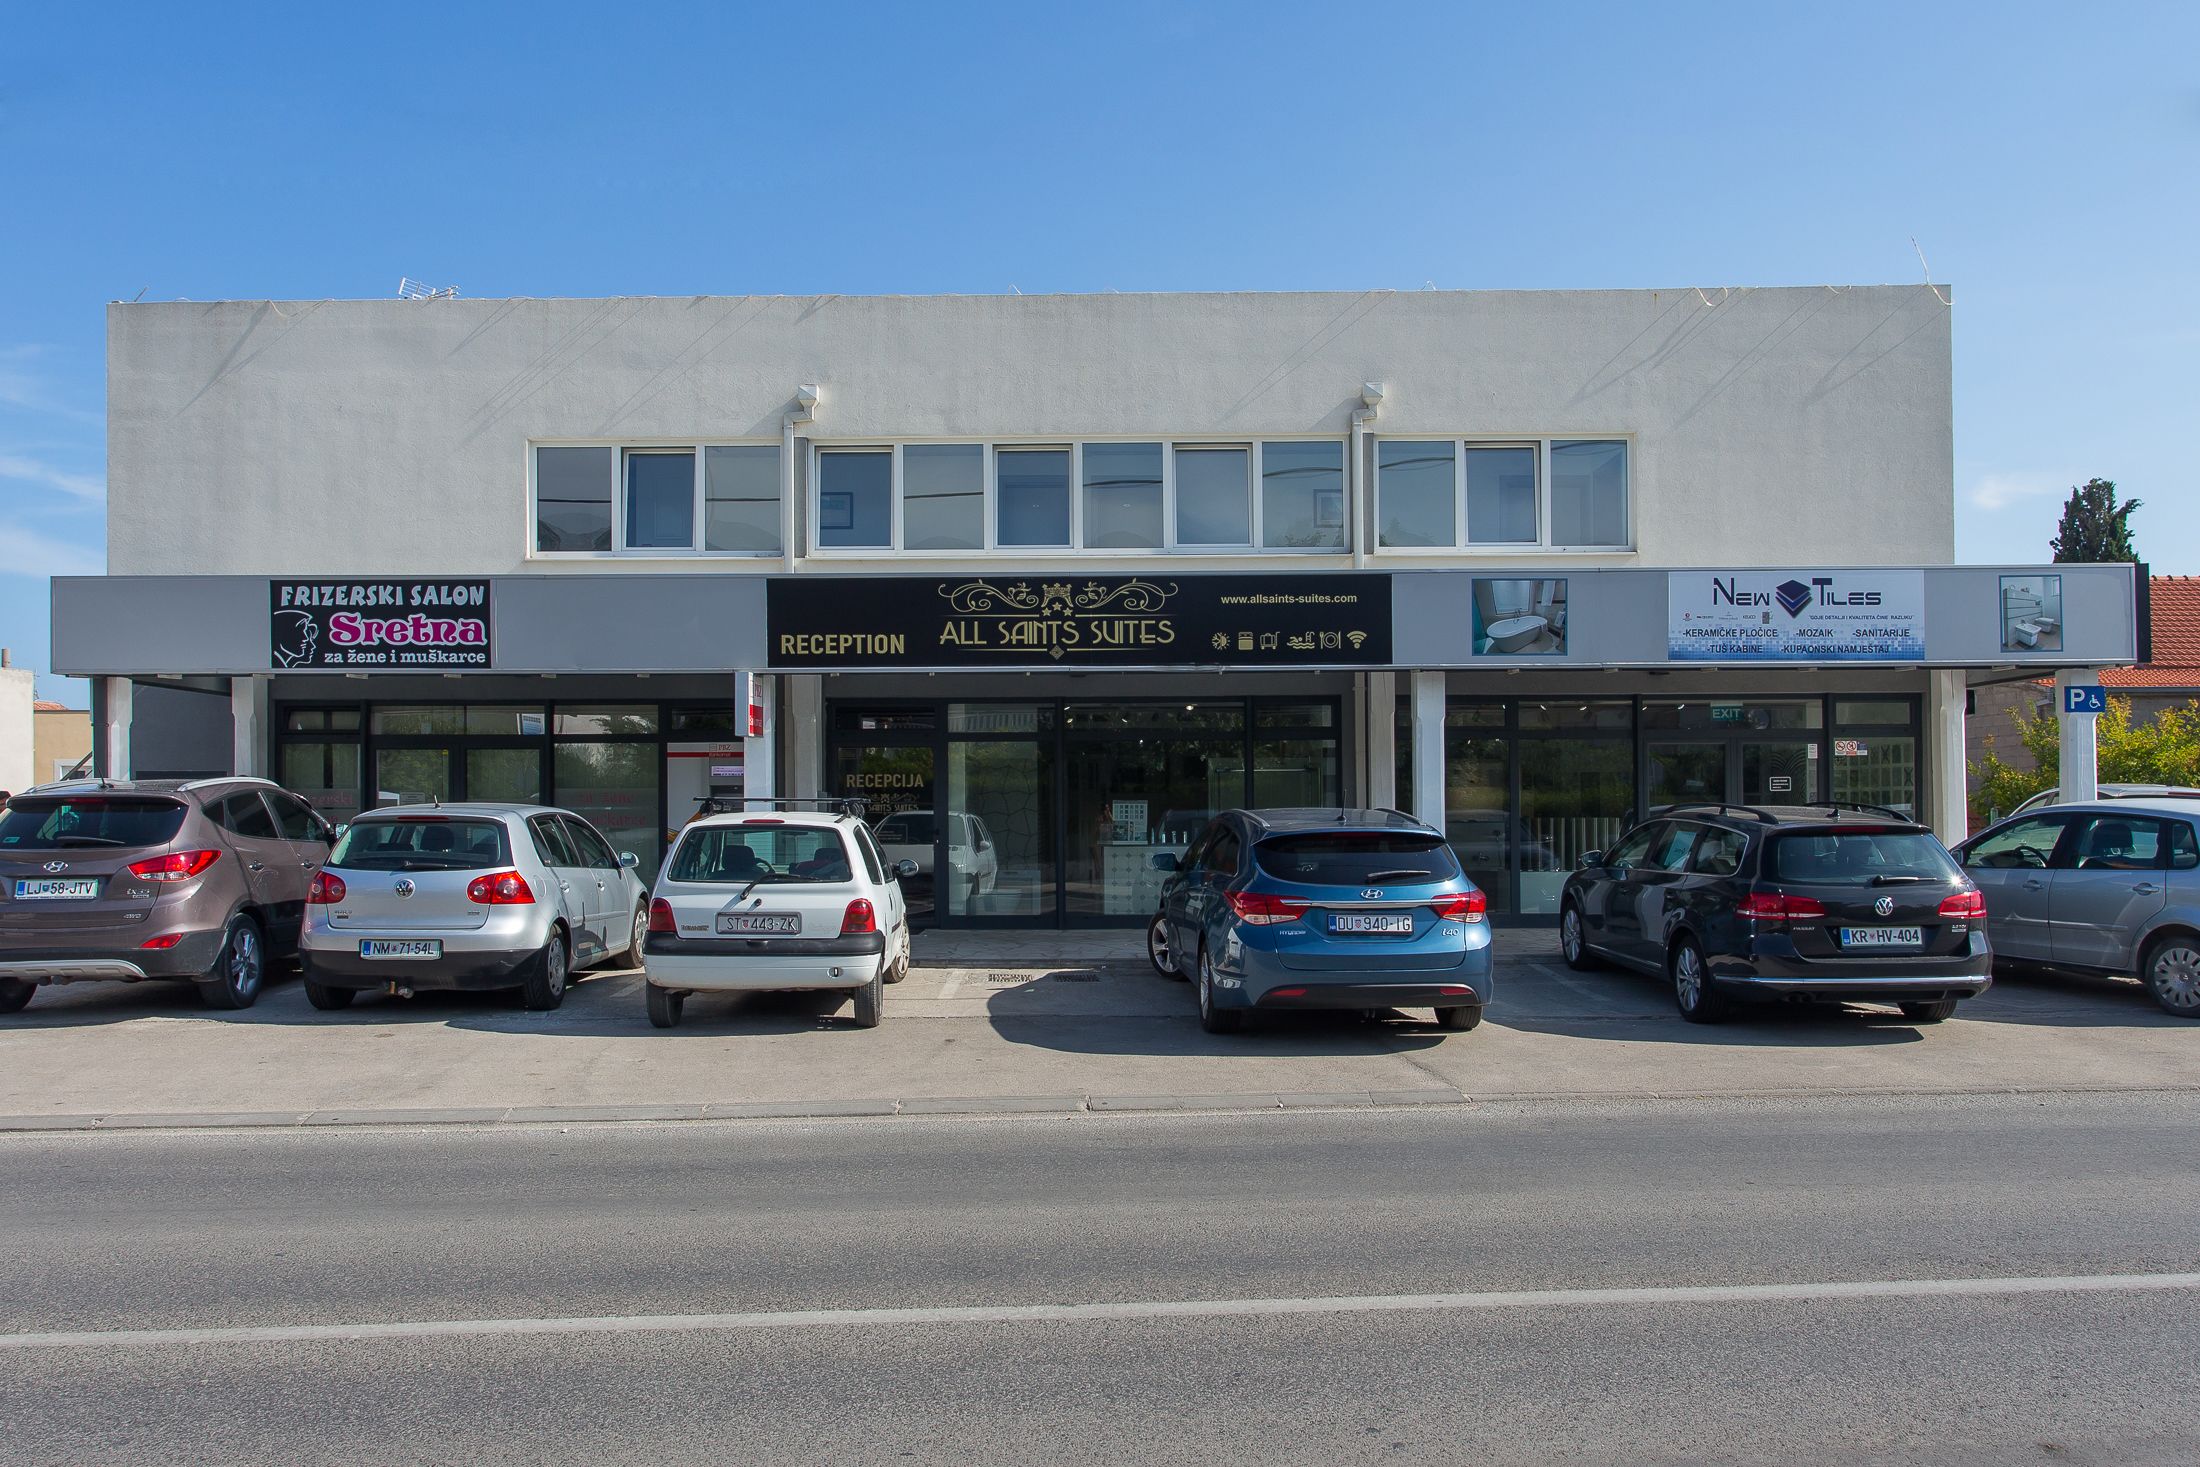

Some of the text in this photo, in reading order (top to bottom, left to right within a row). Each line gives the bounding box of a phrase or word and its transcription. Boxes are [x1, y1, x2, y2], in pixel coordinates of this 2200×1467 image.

[281, 585, 485, 606] FRIZERSKI SALON
[1220, 594, 1358, 604] www.allsaints-suites.com
[329, 612, 488, 646] Sretna
[939, 620, 1176, 645] ALL SAINTS SUITES
[1682, 626, 1910, 638] -KERAMIČKE PLOČICE -MOZAIK -SANITARIJE
[780, 634, 905, 655] RECEPTION
[1729, 645, 1763, 654] KABINE
[1781, 644, 1835, 654] -KUPAONSKI
[1837, 643, 1890, 654] NAMJEŠTAJ
[324, 650, 486, 664] za žene i muškarce
[2070, 688, 2086, 709] P
[1712, 708, 1741, 719] EXIT
[718, 743, 732, 751] PBZ
[846, 774, 924, 788] RECEPCIJA
[27, 882, 93, 895] LJ 58-JTV
[727, 917, 741, 930] ST
[1338, 917, 1354, 931] DU
[1442, 928, 1459, 936] i40
[1851, 929, 1920, 943] KR HV-404
[373, 942, 434, 955] NM 71-54L
